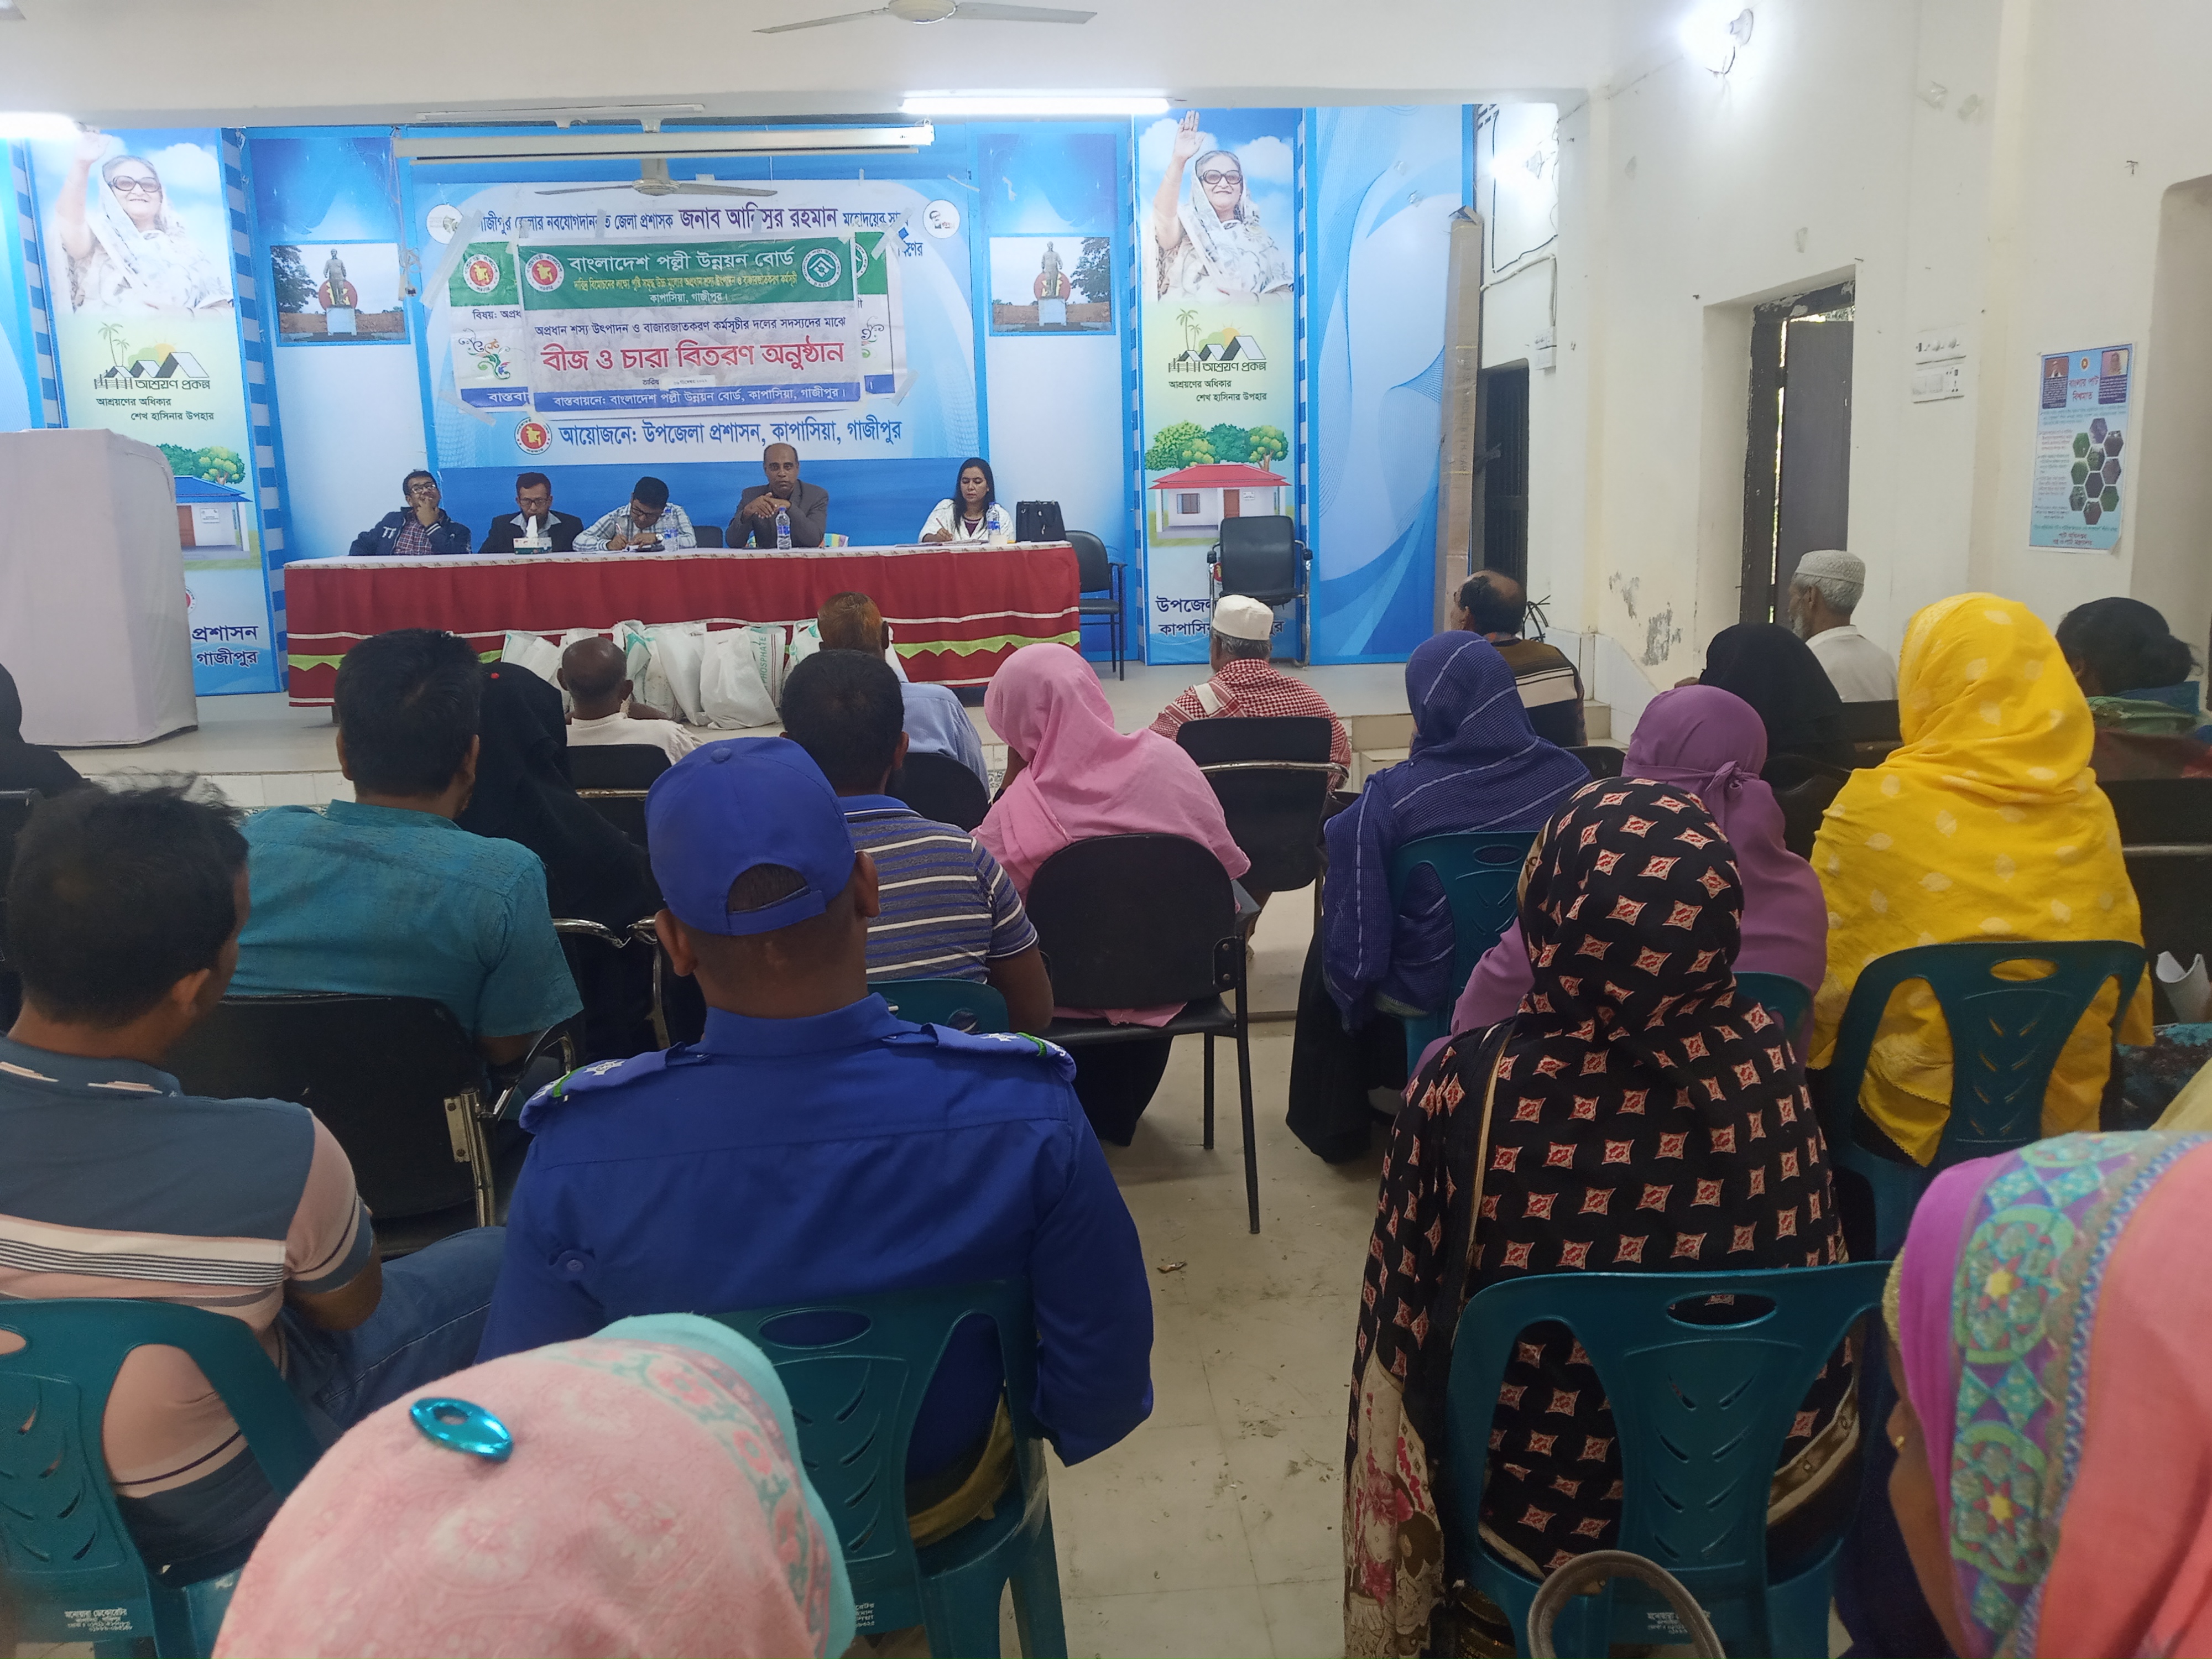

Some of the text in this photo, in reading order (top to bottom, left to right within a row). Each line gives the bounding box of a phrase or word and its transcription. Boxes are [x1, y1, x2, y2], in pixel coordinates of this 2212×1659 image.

[614, 213, 638, 230] জেলা
[640, 212, 674, 230] প্রশাসক
[678, 207, 722, 229] জনাব
[788, 206, 838, 228] রহমান
[567, 254, 651, 273] বাংলাদেশ
[656, 250, 692, 272] পল্লী
[696, 251, 749, 271] উন্নয়ন
[755, 246, 796, 267] বোর্ড
[534, 316, 846, 336] অপ্রধান শস্য উৎপাদন ও বাজারজাতকরণ কর্মসূচীর দলের সদস্যদের মাঝে
[540, 335, 844, 371] বীজ ও চারা বিতরণ অনুষ্ঠান
[1202, 361, 1267, 372] আশ্রয়ণ প্রকল্প
[135, 379, 211, 390] আশ্রয়ণ প্রকল্প
[1168, 378, 1232, 389] আশ্রয়ণের অধিকার
[96, 395, 171, 406] আশ্রয়ণের অধিকার
[609, 393, 657, 405] বাংলাদেশ
[660, 389, 681, 404] পল্লী
[684, 390, 714, 404] উন্নয়ন
[718, 389, 745, 402] বোর্ড,
[748, 387, 797, 400] কাপাসিয়া,
[1196, 392, 1267, 402] শেখ হাসিনার উপহার
[131, 410, 214, 421] শেখ হাসিনার উপহার
[641, 419, 705, 444] উপজেলা
[709, 421, 766, 446] প্রশাসন,
[770, 416, 841, 445] কাপাসিয়া,
[847, 414, 902, 445] গাজীপুর
[192, 625, 259, 643] প্রশাসন
[196, 648, 259, 667] গাজীপুর
[759, 636, 768, 684] PHOSPHATE
